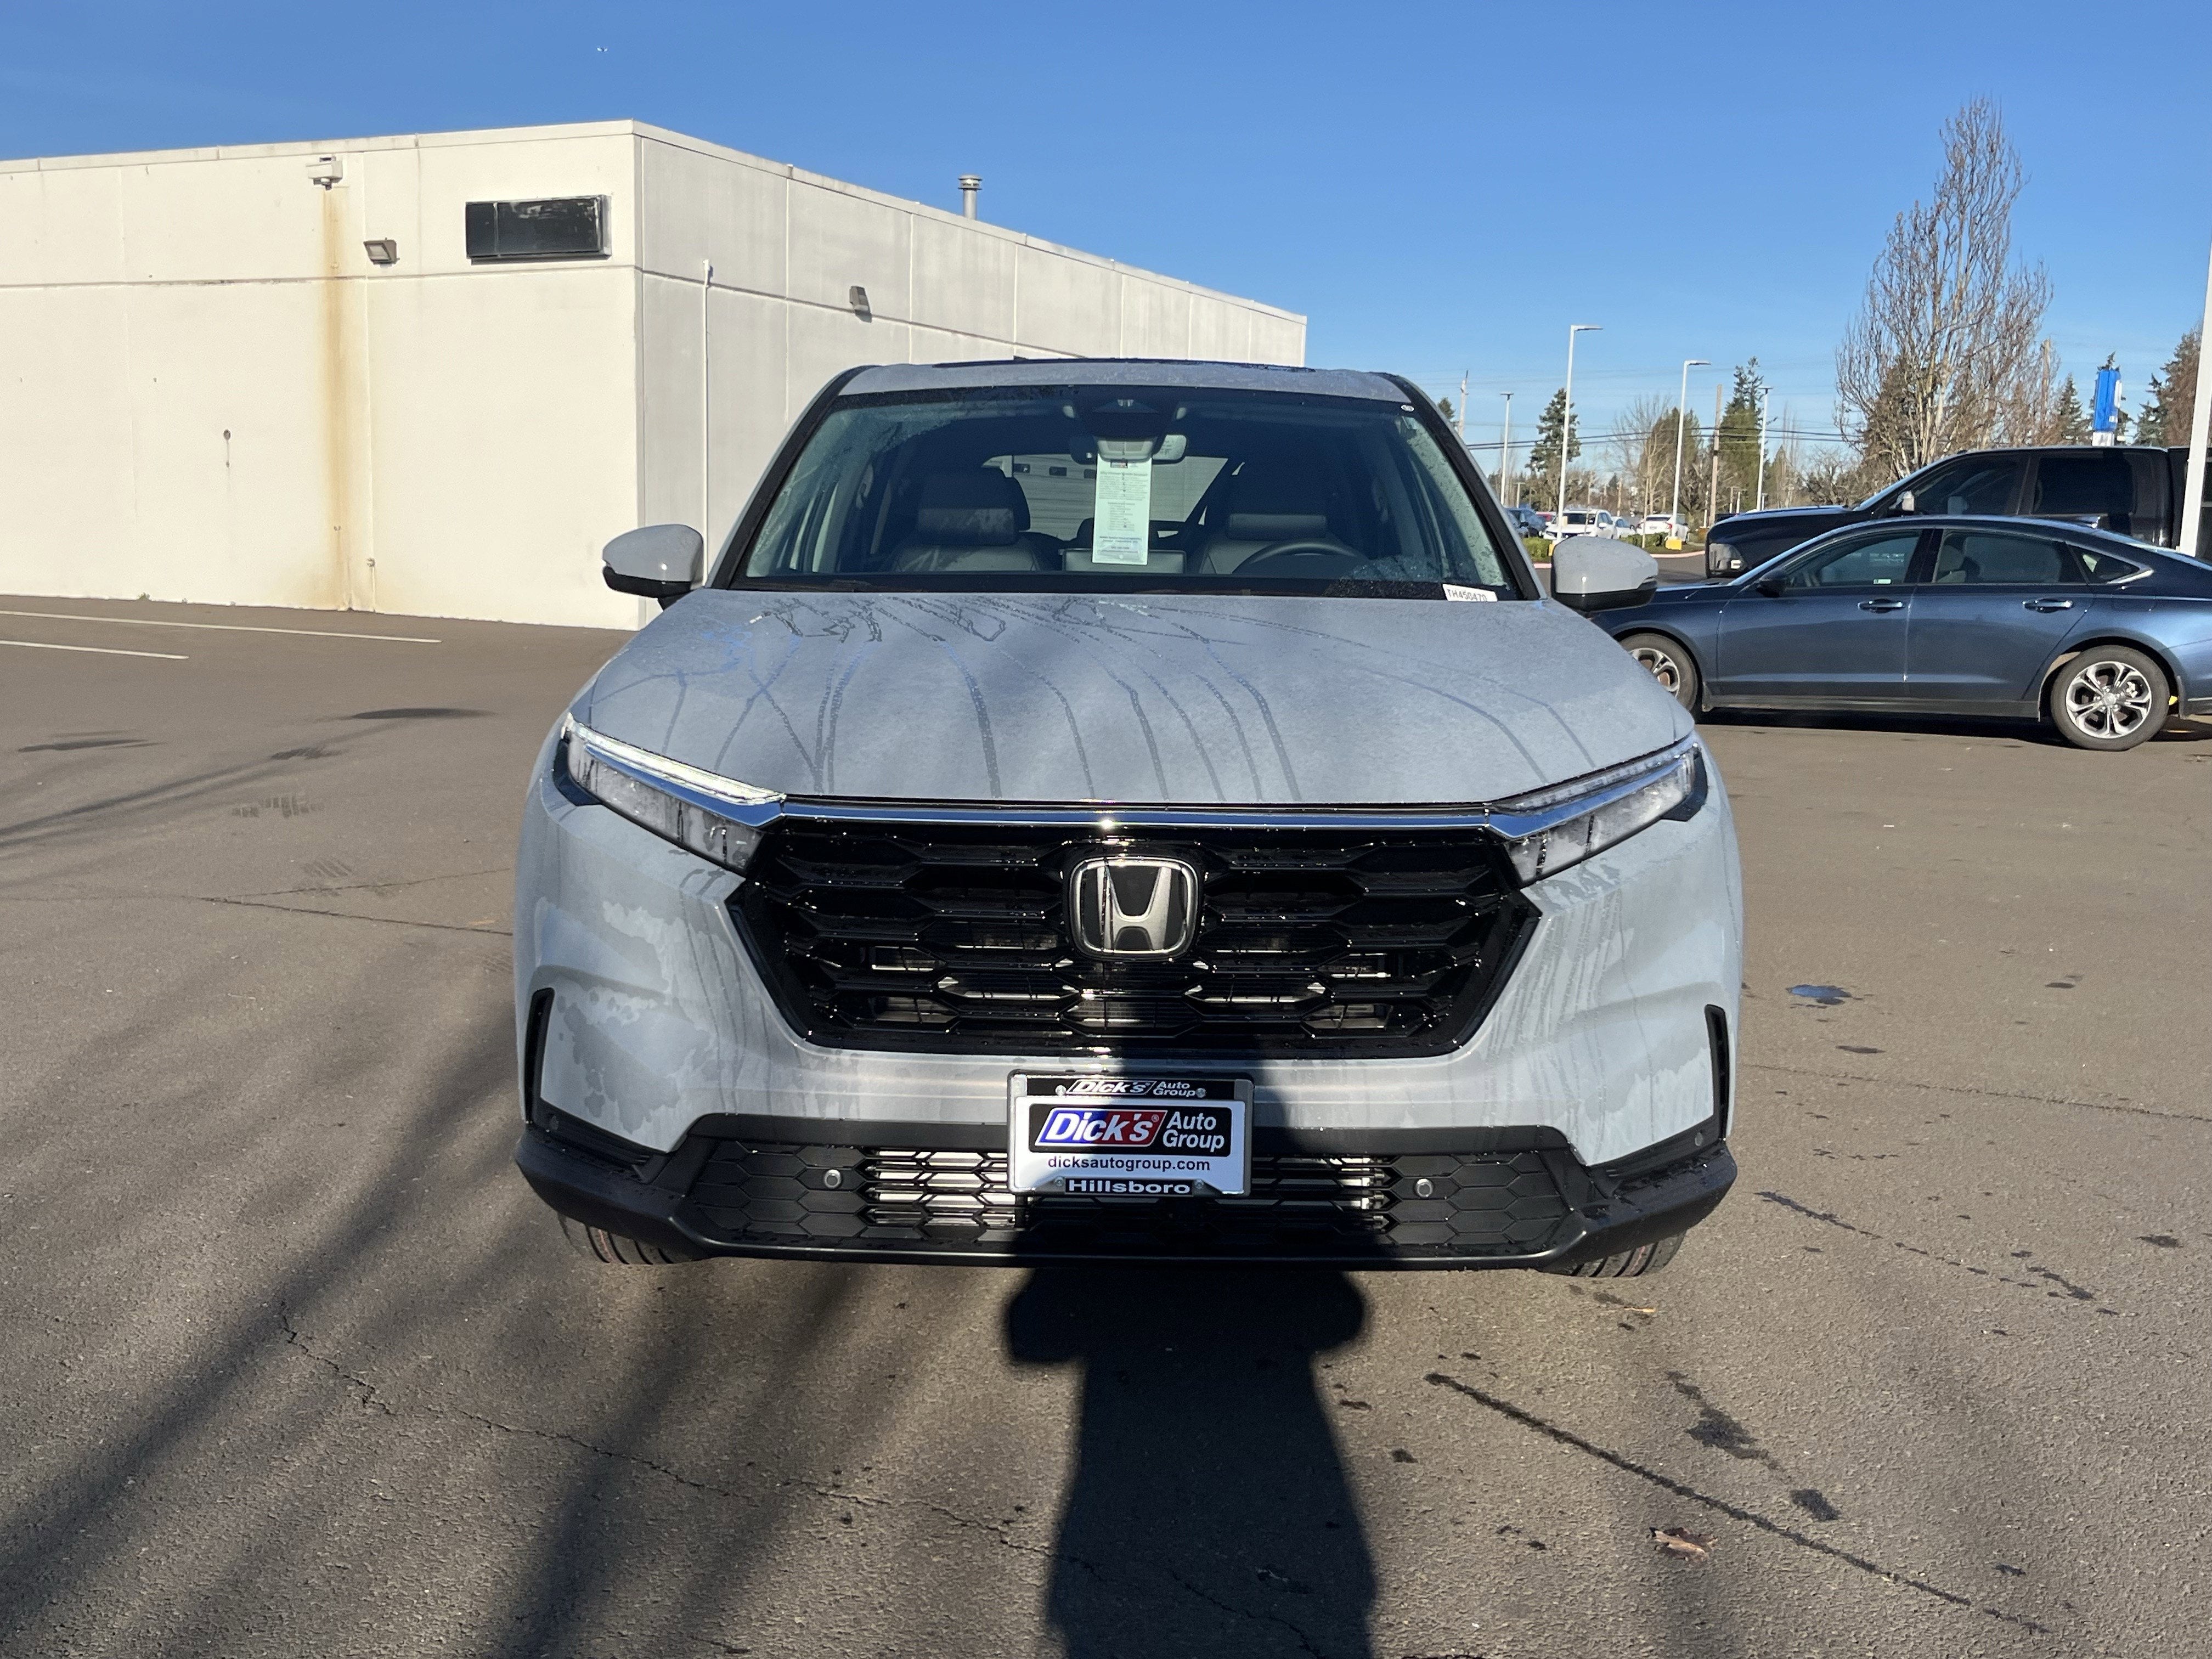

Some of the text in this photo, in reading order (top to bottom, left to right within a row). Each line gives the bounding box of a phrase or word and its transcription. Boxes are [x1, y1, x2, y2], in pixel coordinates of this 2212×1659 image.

[1072, 1081, 1147, 1094] Dick's
[1153, 1088, 1196, 1097] Group
[1156, 1081, 1190, 1089] Auto
[1045, 1112, 1153, 1142] Dick's
[1166, 1111, 1217, 1130] Auto
[1162, 1129, 1225, 1153] Group
[1048, 1155, 1210, 1172] dicksautogroup.com
[1068, 1180, 1190, 1194] Hillsboro
